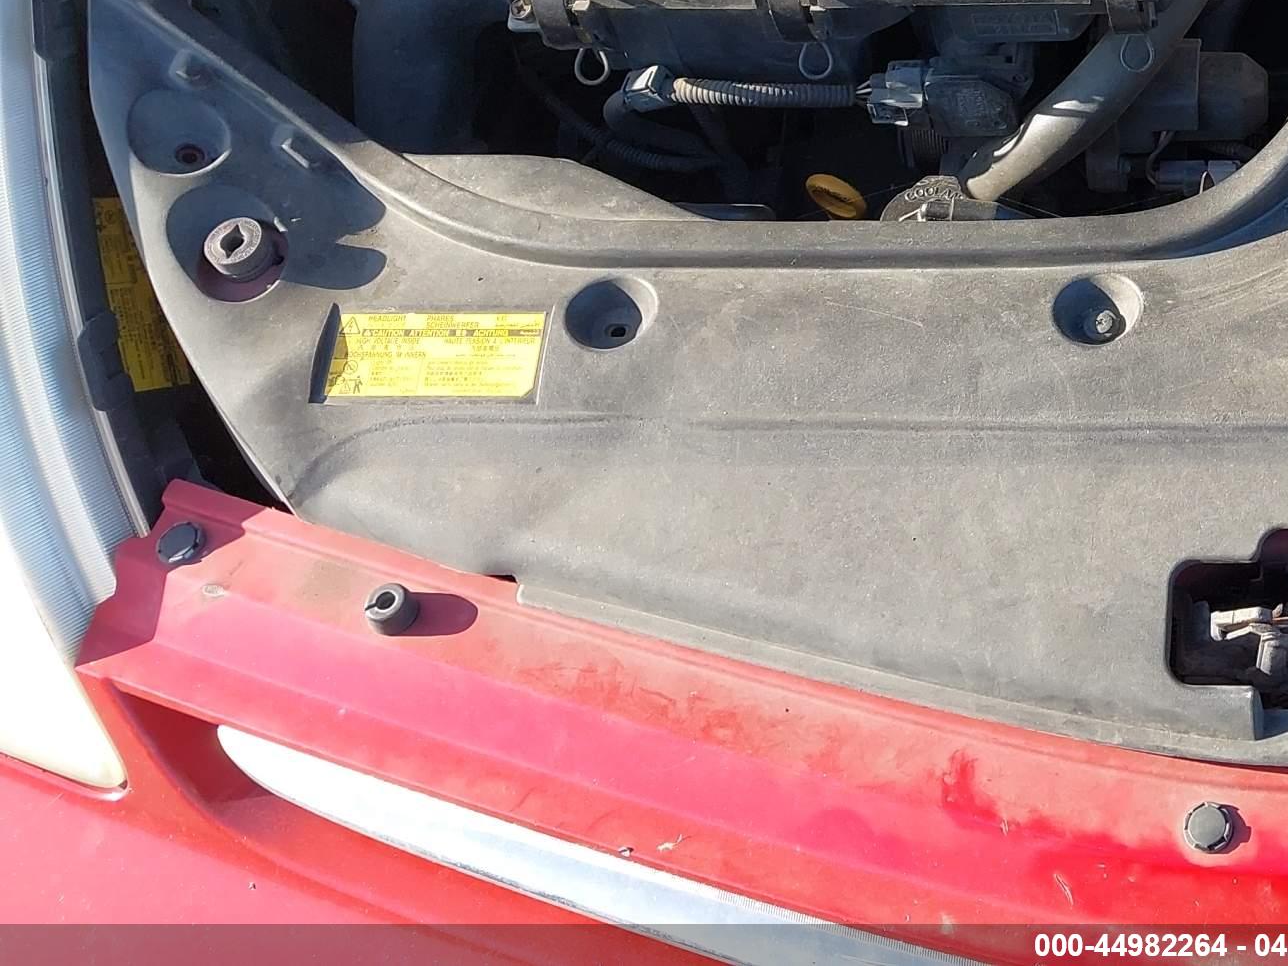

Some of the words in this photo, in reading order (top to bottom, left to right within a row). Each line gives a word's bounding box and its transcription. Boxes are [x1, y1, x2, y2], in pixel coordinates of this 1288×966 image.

[371, 329, 405, 337] CAUTION
[409, 329, 449, 337] ATTENTION
[473, 329, 509, 337] ACHTUNG
